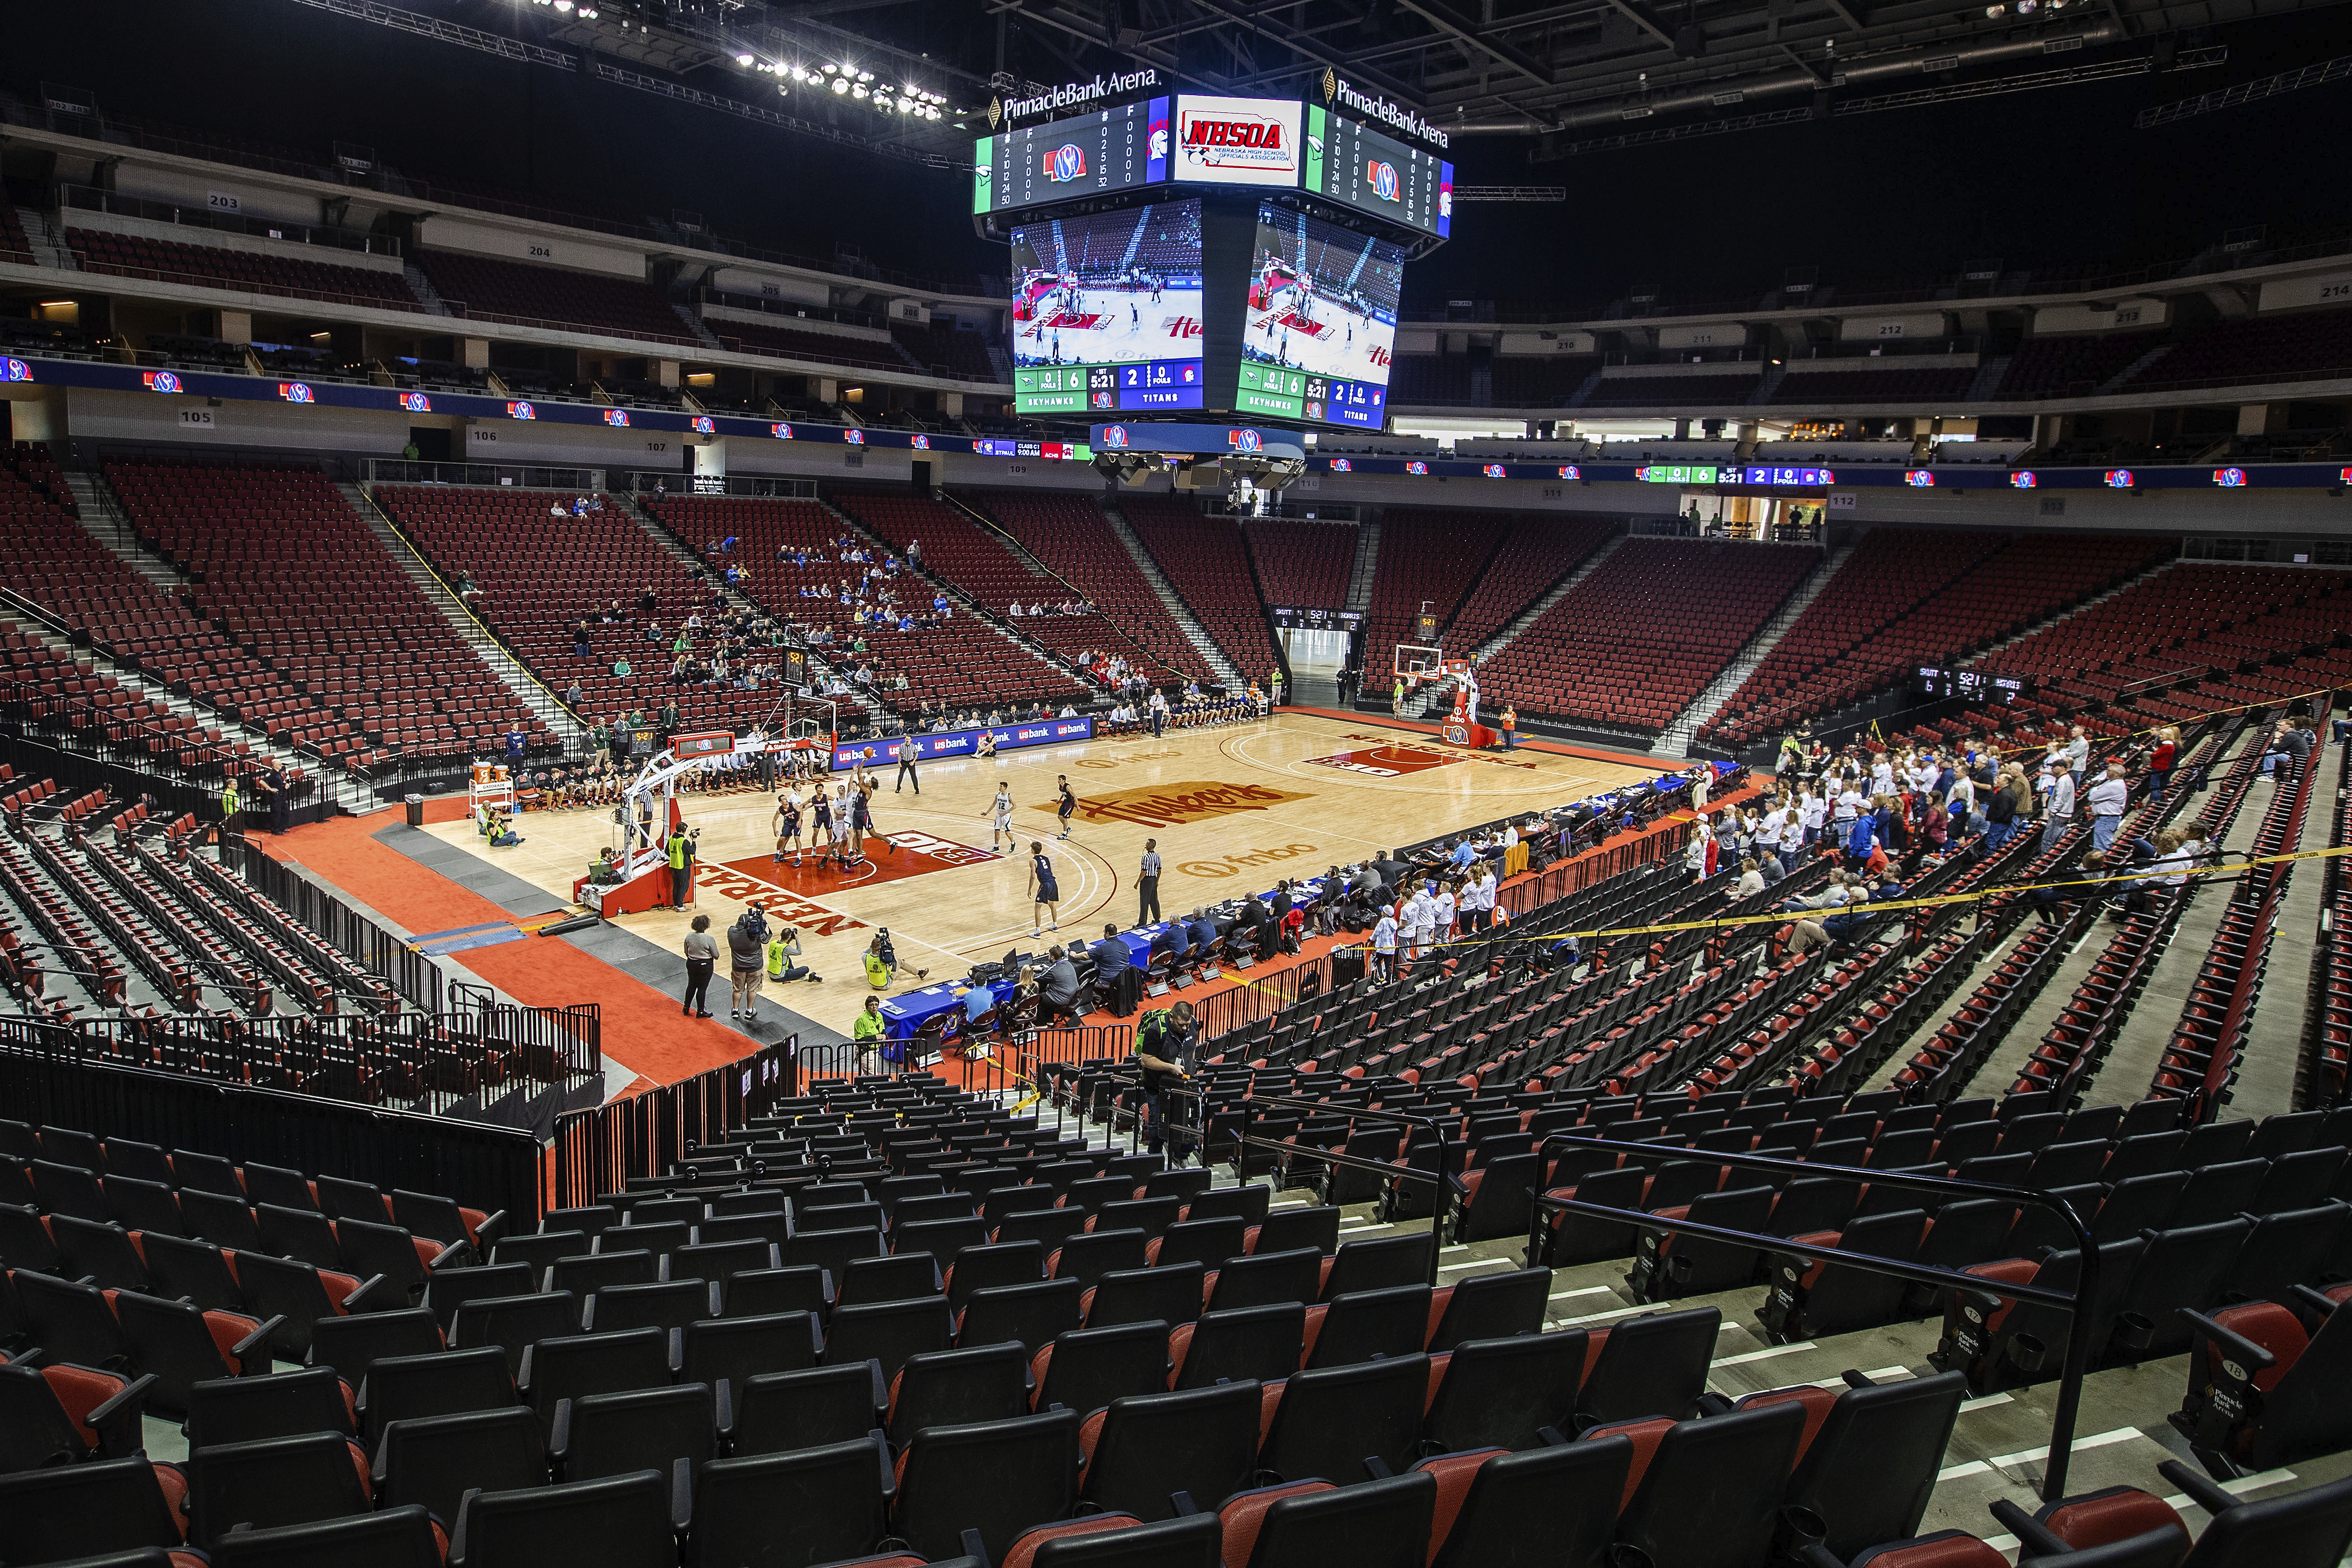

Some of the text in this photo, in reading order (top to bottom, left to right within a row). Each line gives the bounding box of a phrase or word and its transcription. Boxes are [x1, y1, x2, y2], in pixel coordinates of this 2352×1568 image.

[1107, 69, 1156, 95] Arena
[1127, 105, 1133, 116] F
[1027, 128, 1033, 139] F
[1102, 121, 1133, 136] 0 0
[1188, 120, 1280, 149] NHSOA
[1356, 125, 1361, 135] F
[1417, 117, 1448, 148] Arena
[1101, 133, 1132, 149] 2 0
[1336, 133, 1360, 151] 2 0
[1005, 143, 1032, 157] 2 0
[1101, 147, 1131, 162] 5 0
[1335, 145, 1359, 163] 10 0
[1004, 155, 1032, 169] 10 0
[1100, 159, 1131, 175] 15 0
[1334, 158, 1358, 176] 12 0
[1428, 156, 1433, 166] F
[1004, 167, 1031, 181] 12 0
[1411, 164, 1432, 180] 0 0
[1002, 179, 1031, 193] 24 0
[1098, 172, 1131, 187] 32 0
[1332, 171, 1358, 188] 24 0
[1410, 176, 1431, 192] 2 0
[1002, 191, 1031, 205] 50 0
[1331, 183, 1357, 201] 50 0
[1409, 187, 1430, 203] 5 0
[211, 195, 237, 208] 203
[1408, 199, 1429, 215] 15 0
[1407, 210, 1429, 226] 32 0
[530, 247, 549, 257] 204
[763, 286, 778, 295] 205
[2323, 286, 2349, 297] 214
[904, 308, 917, 317] 206
[1881, 321, 1900, 334] 212
[2117, 318, 2138, 327] 213
[1045, 372, 1051, 383] 0
[1128, 369, 1137, 386] 2
[1158, 366, 1166, 378] 0
[1270, 372, 1275, 383] 0
[1071, 373, 1079, 388] 6
[1091, 375, 1114, 388] 5:21
[1264, 382, 1278, 390] FOULS
[1291, 377, 1298, 393] 6
[1143, 393, 1178, 403] TITANS
[1307, 384, 1326, 399] 5:21
[1335, 384, 1343, 401] 2
[1357, 387, 1363, 397] 0
[1028, 397, 1074, 406] SKYHAWKS
[1249, 396, 1291, 410] SKYHAWKS
[182, 411, 210, 422] 105
[1344, 410, 1368, 421] TITANS
[475, 431, 496, 441] 106
[648, 448, 665, 456] 107
[1674, 468, 1681, 476] 0
[1699, 469, 1708, 481] 6
[1719, 473, 1742, 483] 5:21
[1755, 470, 1764, 482] 2
[1785, 470, 1793, 478] 0
[1311, 610, 1327, 619] 5:21
[1350, 622, 1356, 630] 2
[1422, 618, 1435, 626] 5:21
[790, 652, 803, 664] 5:21
[1920, 668, 1939, 677] SKUTT
[1959, 672, 1980, 686] 5:21
[1926, 680, 1933, 692] 6
[1450, 715, 1465, 724] fnbo
[636, 732, 652, 741] 5:21
[1117, 751, 1183, 763] fnbo
[1339, 734, 1537, 769] NEBRASKA
[649, 773, 670, 786] SPORTS
[1051, 783, 1284, 828] Huskers
[1223, 843, 1318, 866] fnbo
[2293, 851, 2319, 860] CAUTION
[1041, 860, 1048, 869] 2
[1969, 1310, 1978, 1320] 17
[2229, 1364, 2241, 1377] 18
[2215, 1395, 2230, 1409] Bank
[2216, 1389, 2243, 1409] Pinnacle
[2213, 1402, 2234, 1418] Arena
